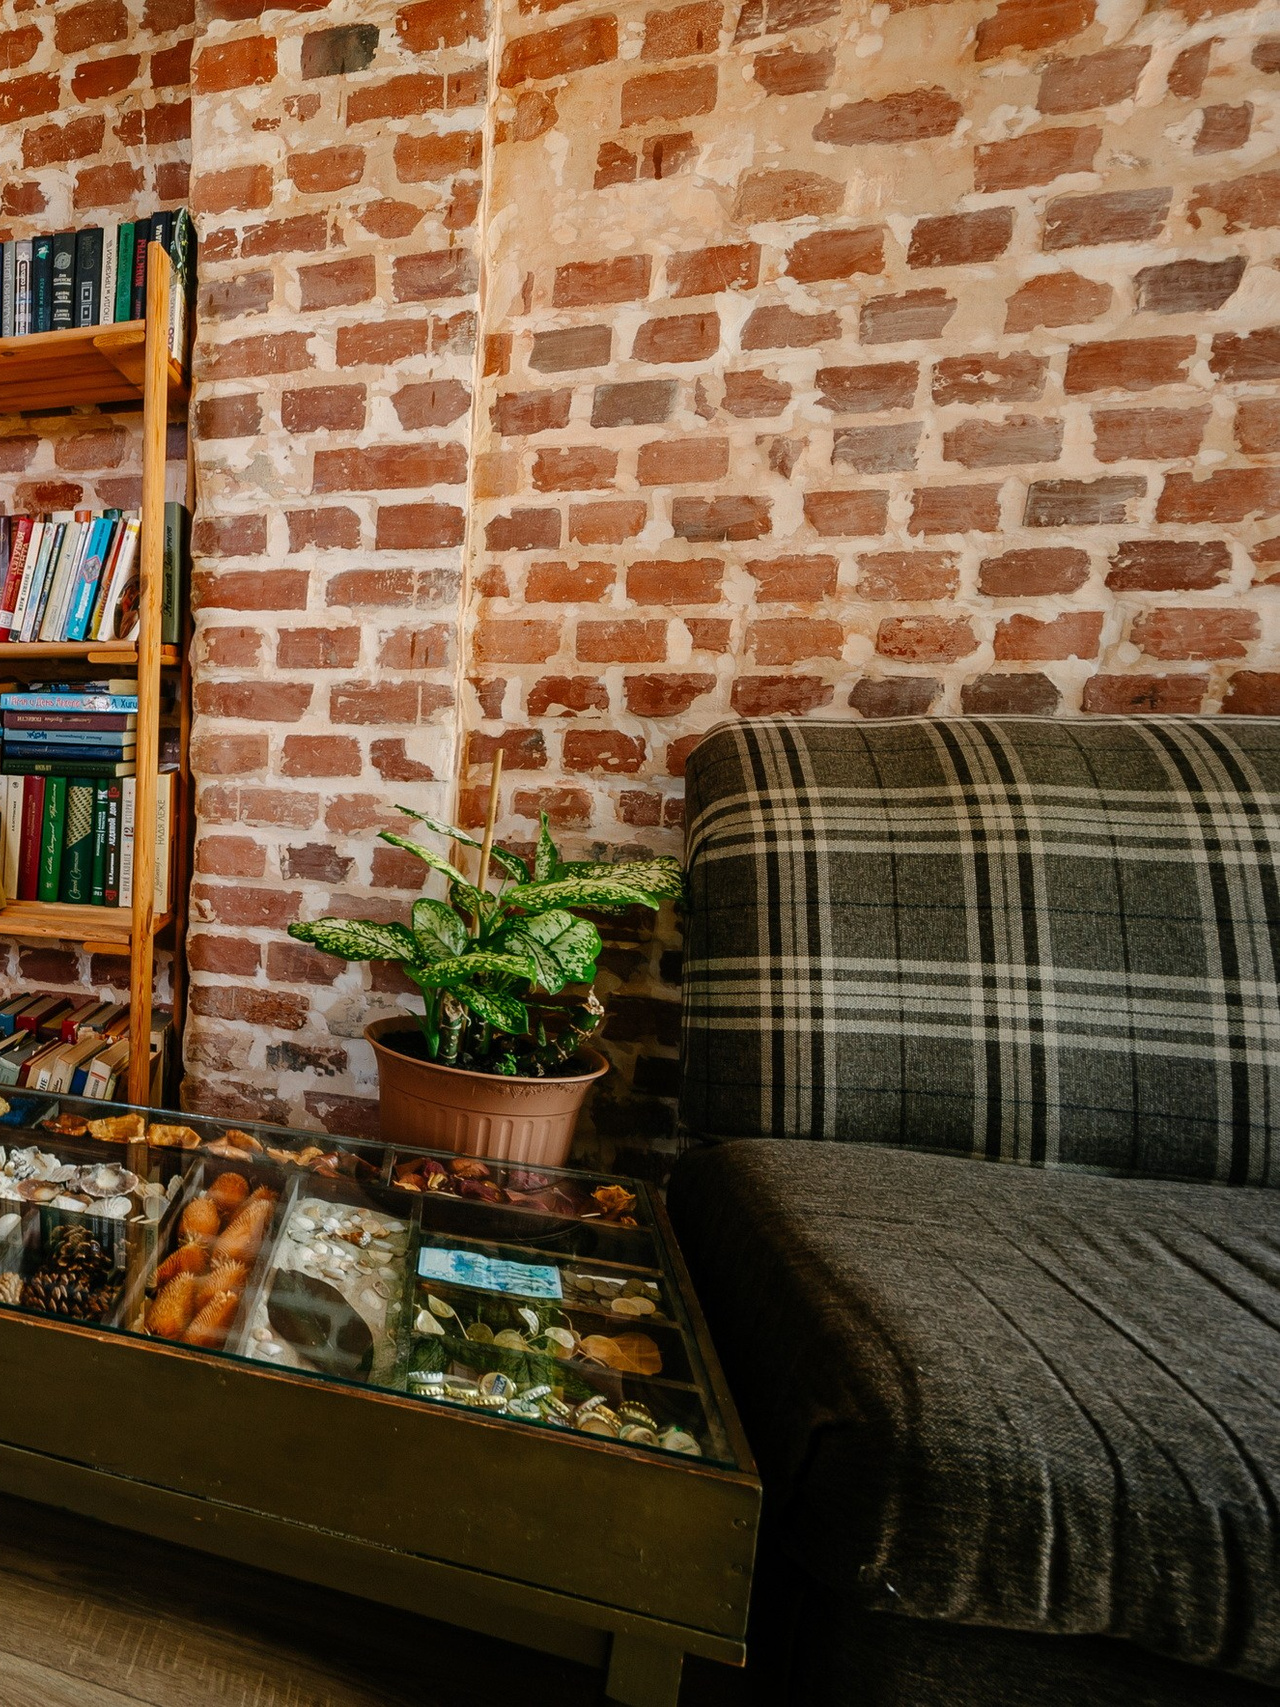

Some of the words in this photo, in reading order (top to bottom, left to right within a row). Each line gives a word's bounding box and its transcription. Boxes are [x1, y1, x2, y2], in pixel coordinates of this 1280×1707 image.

[4, 251, 13, 281] ЦЕНТРА
[136, 239, 147, 287] МОНСТРЫ
[2, 283, 12, 324] ЗАДАНИЮ
[10, 531, 24, 576] ГОЛУБАЯ
[109, 802, 117, 816] ДОМ
[124, 799, 133, 824] ИСТОРИЙ
[157, 799, 165, 822] ЛЕЖЕ
[107, 817, 117, 846] ЛЕДЯНОЙ
[123, 827, 134, 838] 12
[157, 824, 165, 845] НАДЯ
[123, 853, 131, 877] ЯКОВЛЕВ
